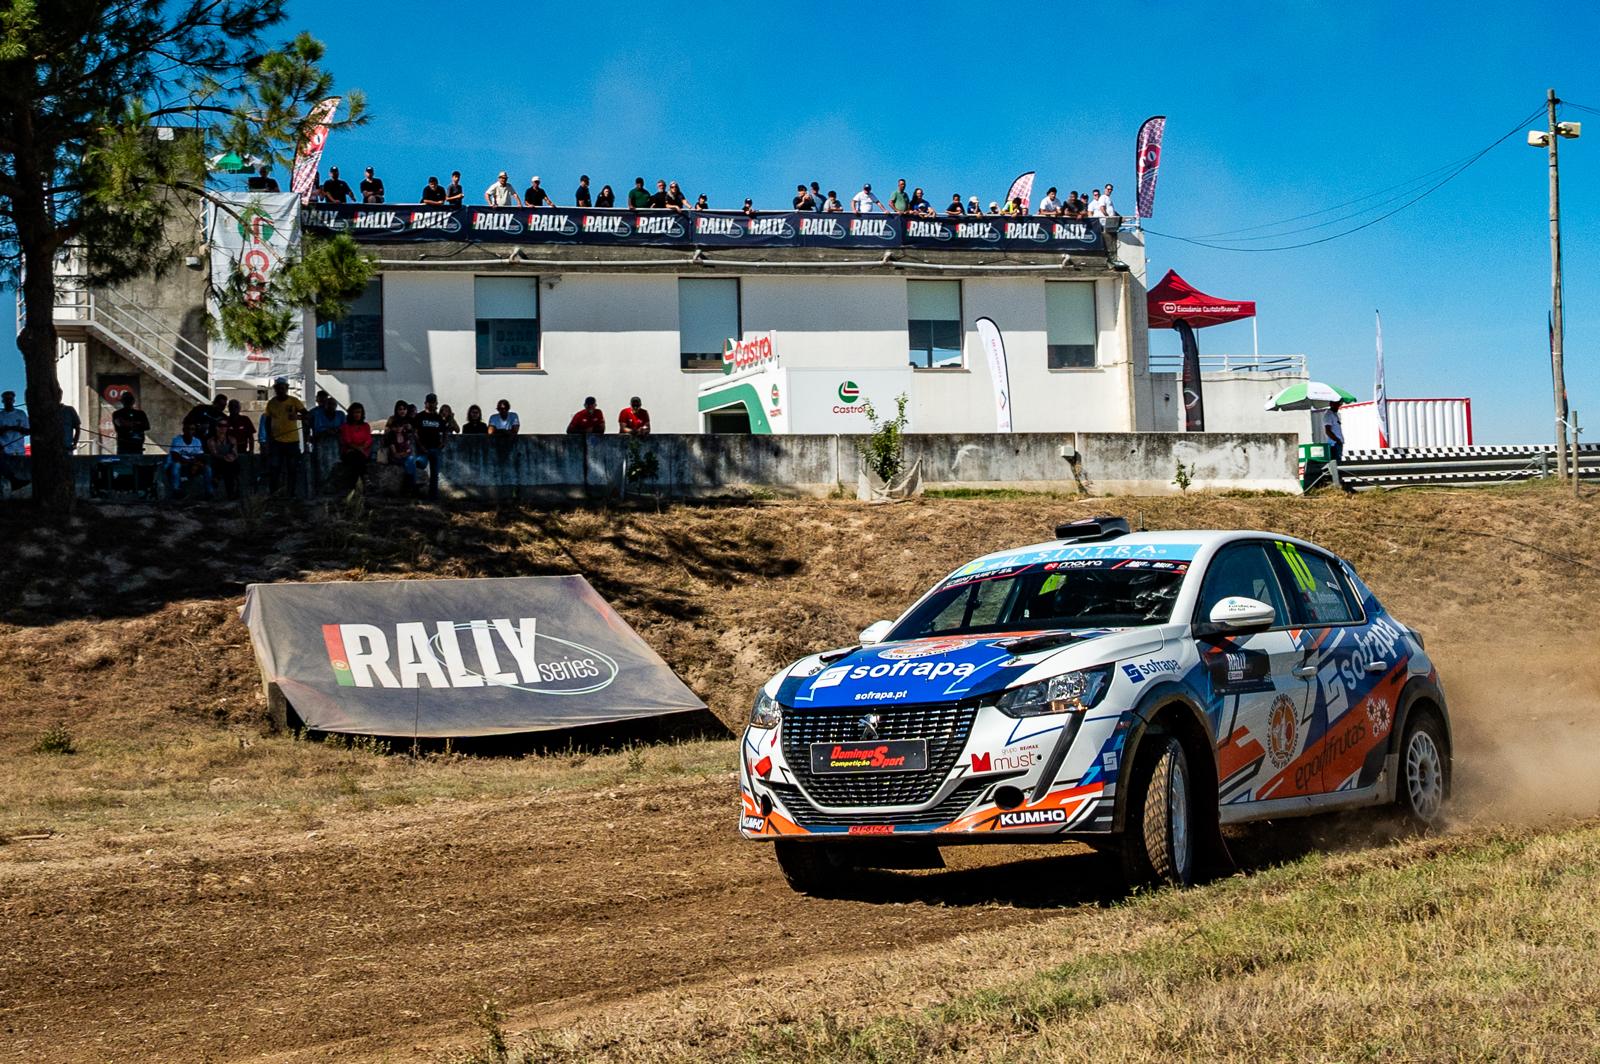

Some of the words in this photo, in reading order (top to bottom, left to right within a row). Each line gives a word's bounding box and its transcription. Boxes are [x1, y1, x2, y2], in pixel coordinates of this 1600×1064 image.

[356, 211, 396, 228] RALLY
[412, 211, 452, 229] RALLY
[475, 213, 514, 230] RALLY
[530, 214, 569, 232] RALLY
[584, 215, 622, 233] RALLY
[638, 216, 675, 234] RALLY
[698, 217, 734, 235] RALLY
[750, 218, 786, 235] RALLY
[801, 218, 837, 236] RALLY
[853, 219, 887, 236] RALLY
[909, 220, 942, 237] RALLY
[958, 222, 992, 239] RALLY
[1007, 222, 1040, 239] RALLY
[1055, 223, 1087, 240] RALLY
[1037, 545, 1157, 560] SINTRA
[339, 617, 542, 689] RALLY
[540, 655, 599, 683] series
[1341, 617, 1400, 690] sofrapa
[850, 660, 975, 680] sofrapa
[1139, 659, 1181, 675] sofrapa
[855, 690, 907, 700] sofrapa.pt
[994, 751, 1036, 770] must
[1000, 809, 1066, 825] KUMHO
